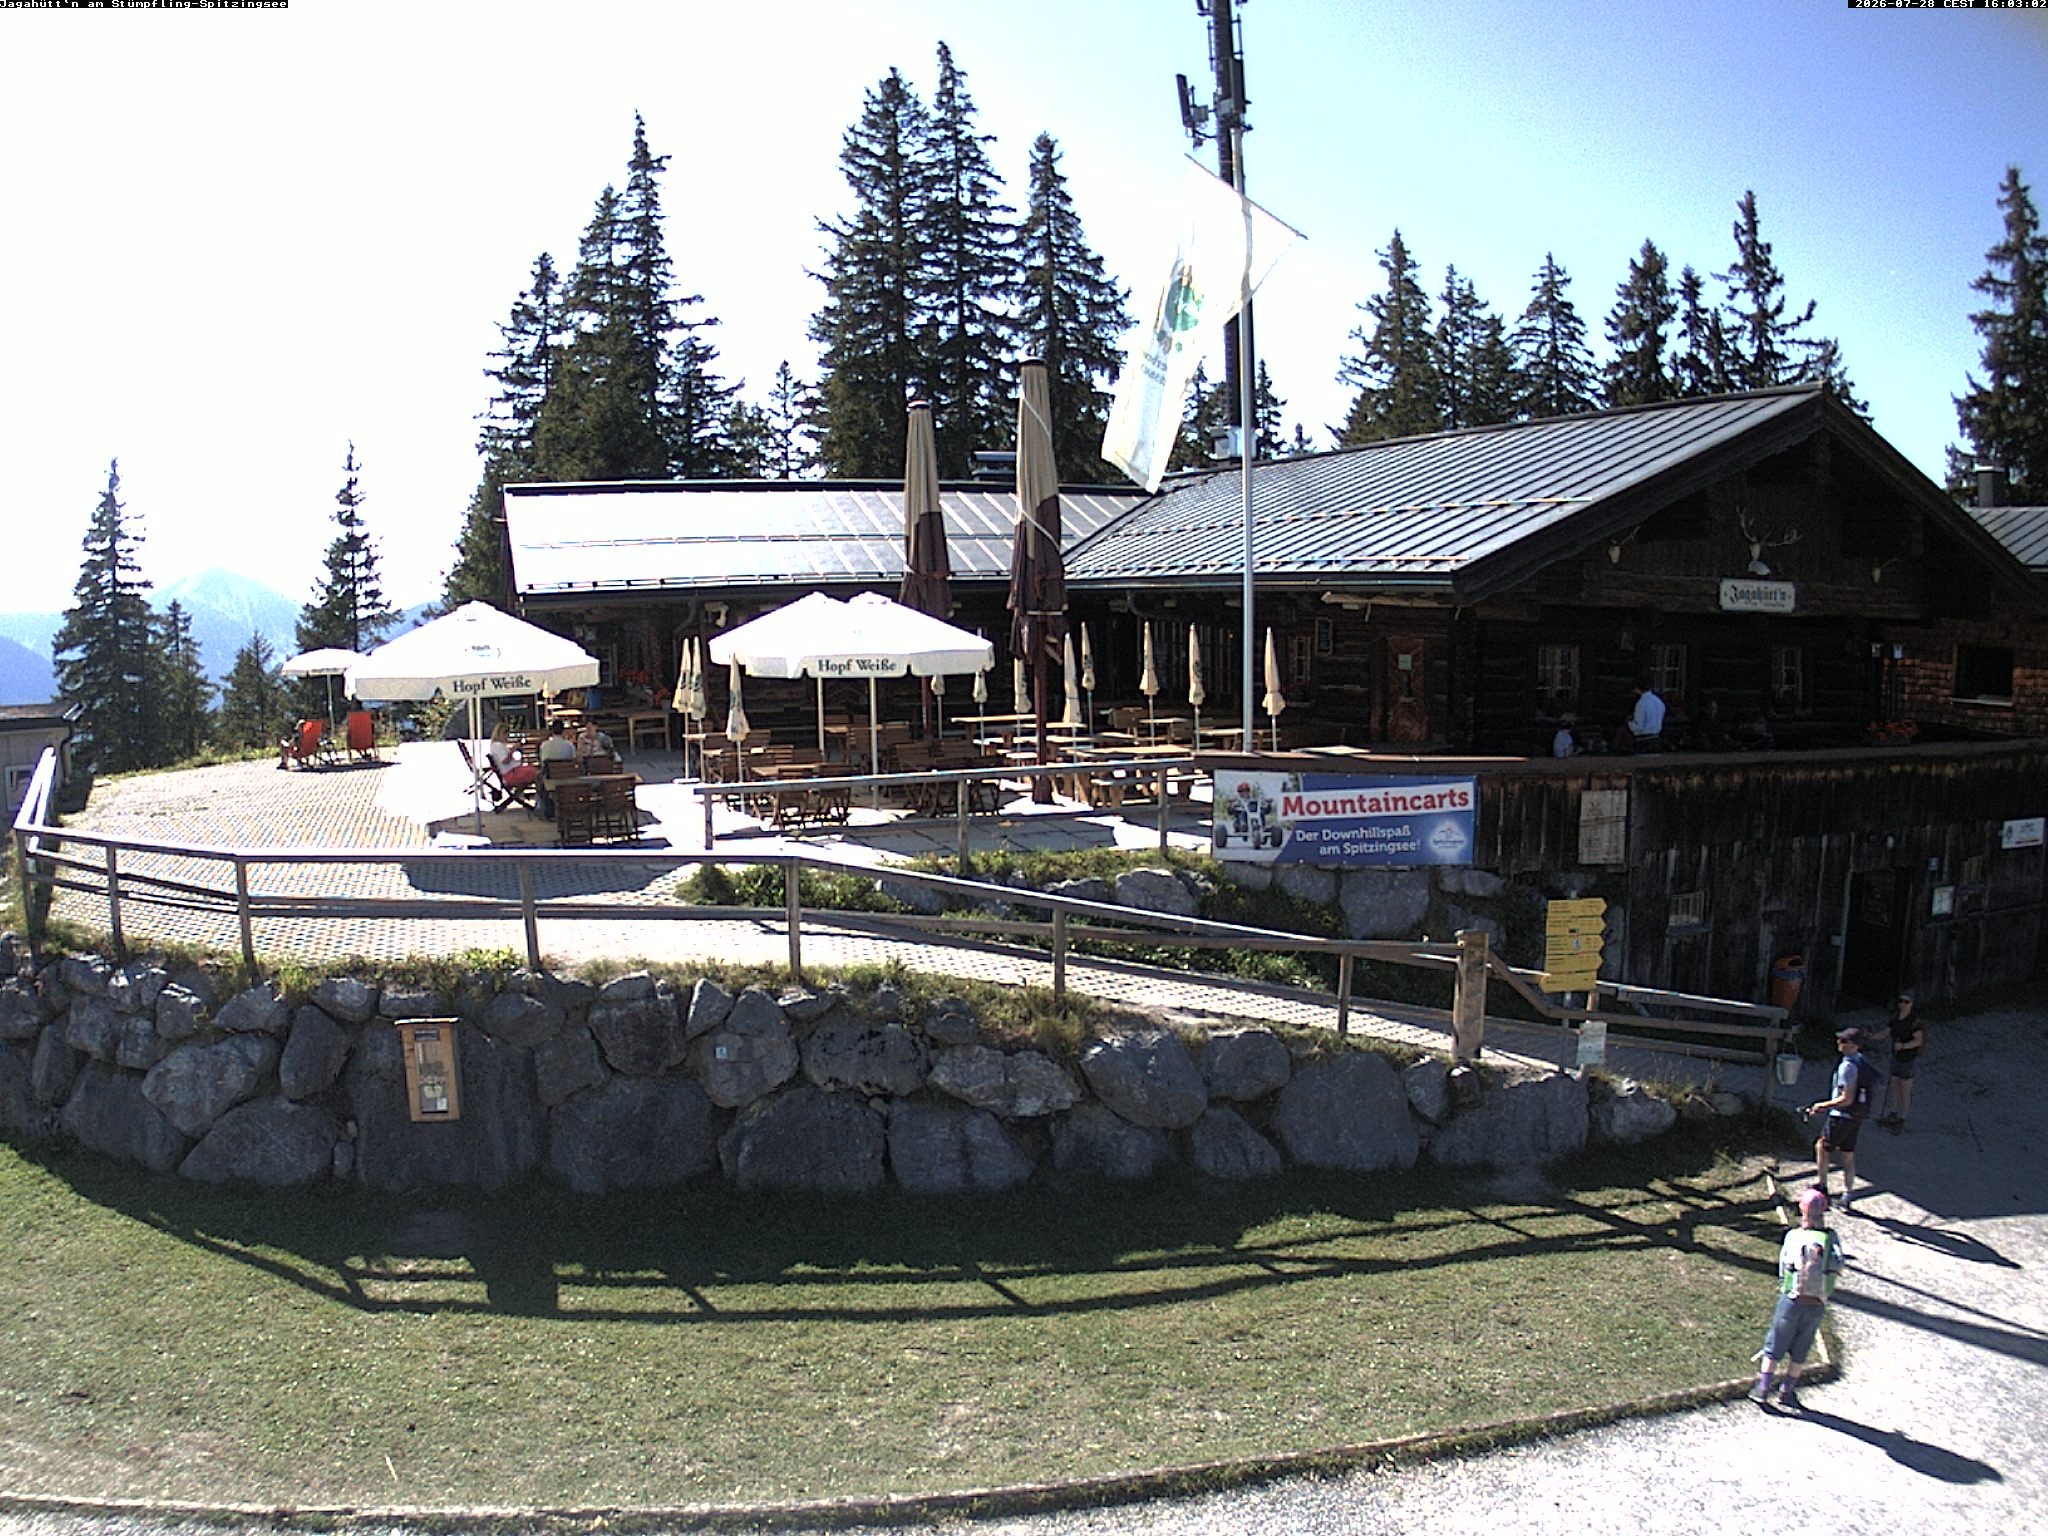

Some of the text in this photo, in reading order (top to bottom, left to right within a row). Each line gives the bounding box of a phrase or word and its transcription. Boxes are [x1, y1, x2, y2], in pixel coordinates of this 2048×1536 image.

[817, 658, 896, 675] Hopf Weiße
[453, 675, 531, 694] Hopf Weiße
[1281, 788, 1469, 817] Mountaincarts
[1296, 825, 1411, 842] Der Downhillspaß
[1319, 845, 1341, 856] am
[1343, 839, 1421, 856] Spitzingsee!
